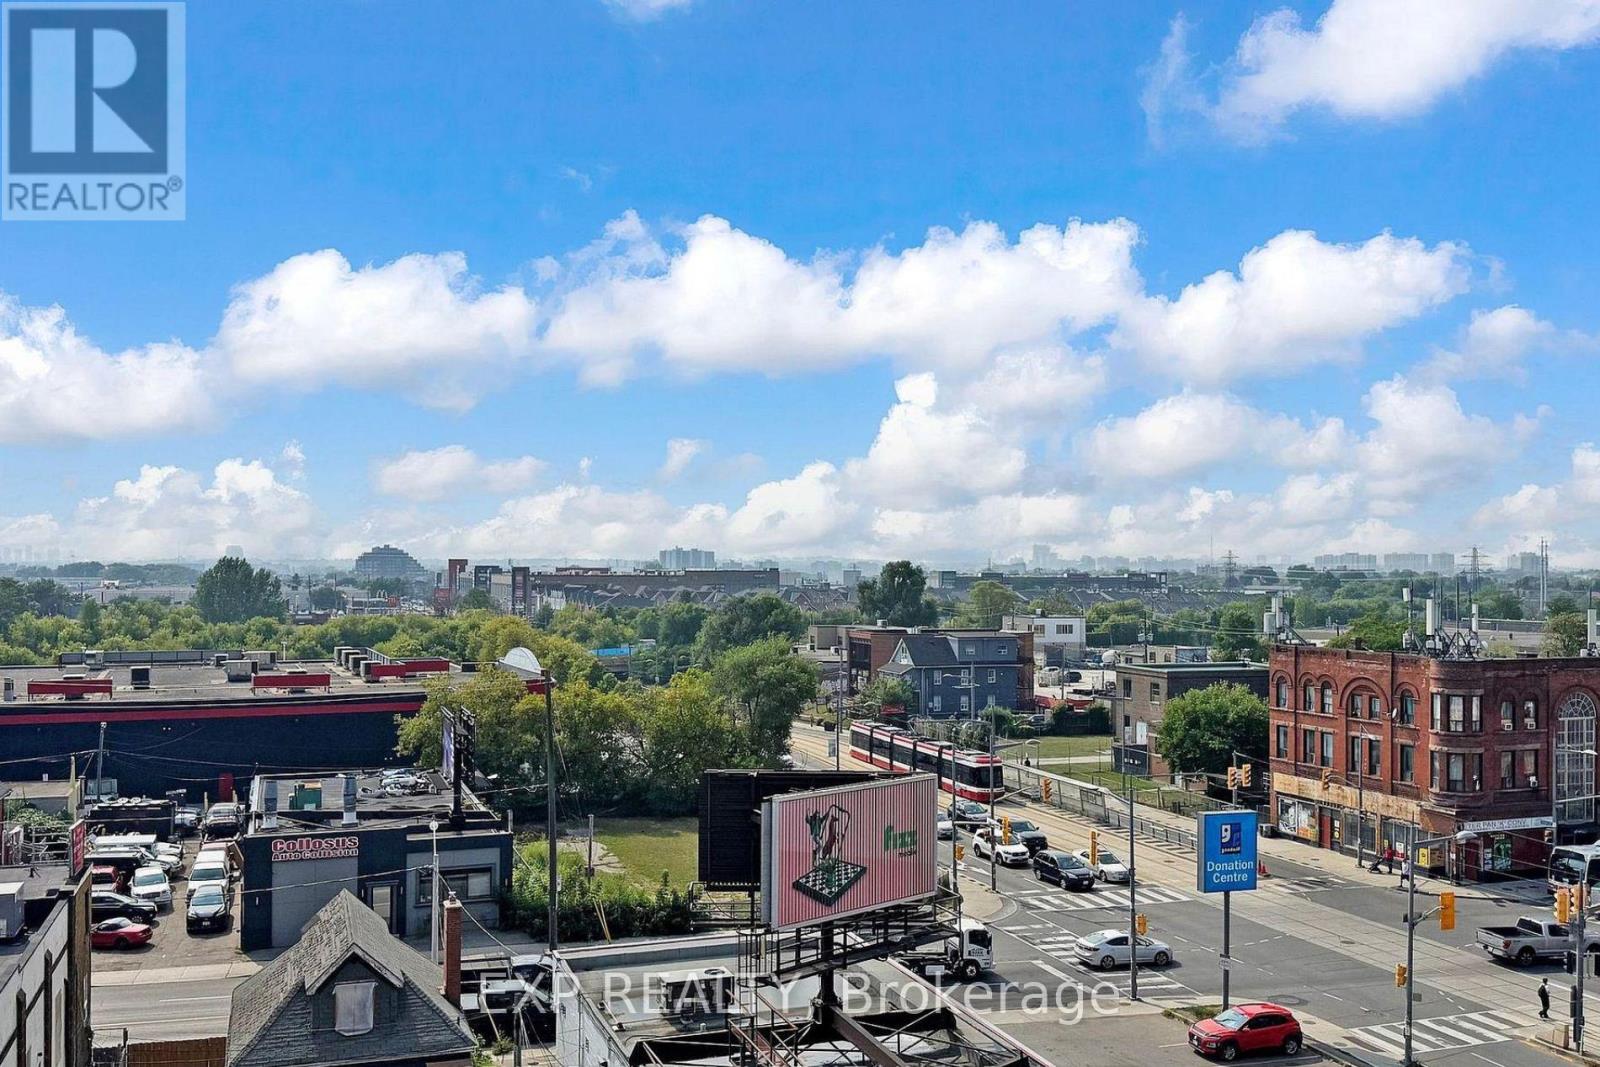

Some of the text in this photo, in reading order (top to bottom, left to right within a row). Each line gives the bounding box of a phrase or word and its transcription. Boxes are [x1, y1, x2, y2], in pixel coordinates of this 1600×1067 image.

[272, 836, 358, 852] Collosus
[272, 849, 358, 861] Auto Collision
[1207, 860, 1254, 872] Donation
[1212, 872, 1248, 883] Centre
